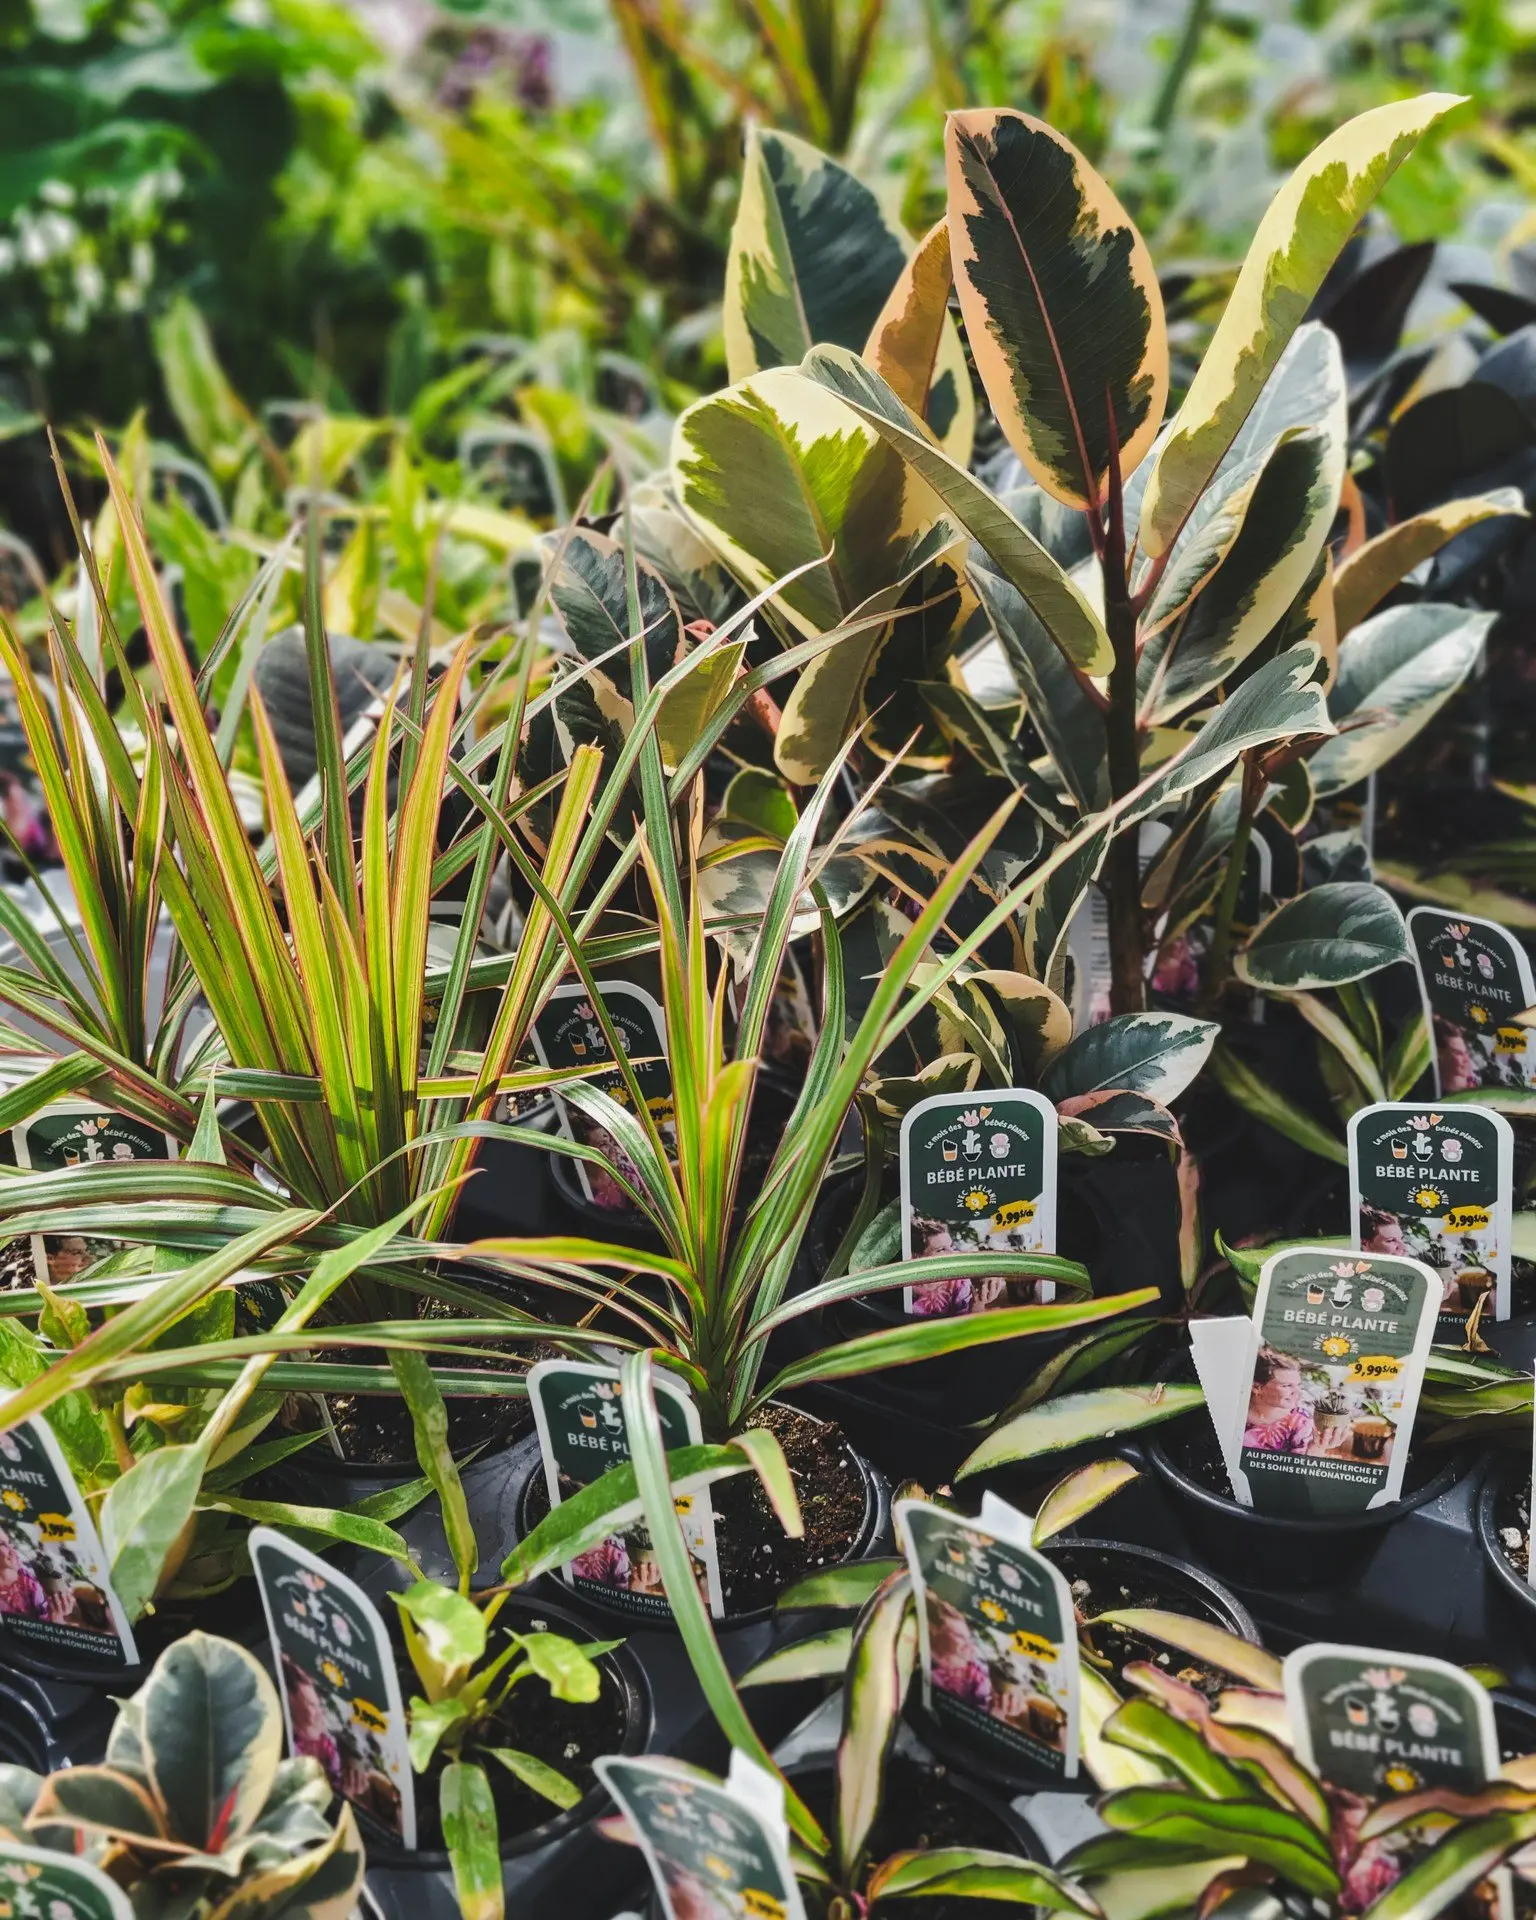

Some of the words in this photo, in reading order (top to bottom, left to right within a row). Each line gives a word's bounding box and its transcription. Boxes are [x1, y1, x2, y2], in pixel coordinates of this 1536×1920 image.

[1467, 981, 1512, 1003] PLANTE
[620, 1016, 645, 1035] plantes
[67, 1132, 81, 1140] des
[104, 1129, 127, 1138] bébés
[128, 1135, 153, 1152] plantes
[924, 1142, 934, 1150] Le
[931, 1129, 948, 1142] mois
[948, 1123, 962, 1132] des
[985, 1119, 1008, 1128] bébés
[1007, 1123, 1030, 1141] plantes
[1381, 1130, 1397, 1141] mois
[1397, 1126, 1412, 1134] des
[1435, 1126, 1459, 1135] bébés
[1459, 1131, 1484, 1149] plantes
[927, 1167, 964, 1184] BÉBÉ
[968, 1164, 1026, 1181] PLANTE
[1376, 1164, 1415, 1178] BÉBÉ
[1419, 1167, 1480, 1182] PLANTE
[956, 1190, 968, 1208] AVEC
[1407, 1187, 1419, 1203] AVEC
[1297, 1273, 1317, 1285] mois
[1359, 1273, 1385, 1284] bébés
[1284, 1309, 1327, 1326] BÉBÉ
[1331, 1315, 1398, 1334] PLANTE
[1312, 1333, 1328, 1351] AVEC
[567, 1432, 608, 1451] BÉBÉ
[1246, 1451, 1259, 1459] AU
[1261, 1453, 1292, 1463] PROFIT
[1294, 1457, 1305, 1466] DE
[1307, 1459, 1318, 1467] LA
[1319, 1461, 1371, 1475] RECHERCHE
[1372, 1468, 1383, 1476] ET
[1249, 1461, 1266, 1469] DES
[1267, 1463, 1294, 1473] SOINS
[1295, 1466, 1307, 1474] EN
[1308, 1468, 1377, 1485] NÉONATOLOGIE
[0, 1465, 48, 1488] LANTE
[579, 1580, 589, 1588] AU
[591, 1584, 618, 1597] PROFIT
[620, 1593, 631, 1601] DE
[633, 1595, 643, 1604] LA
[1385, 1738, 1462, 1766] PLANTE
